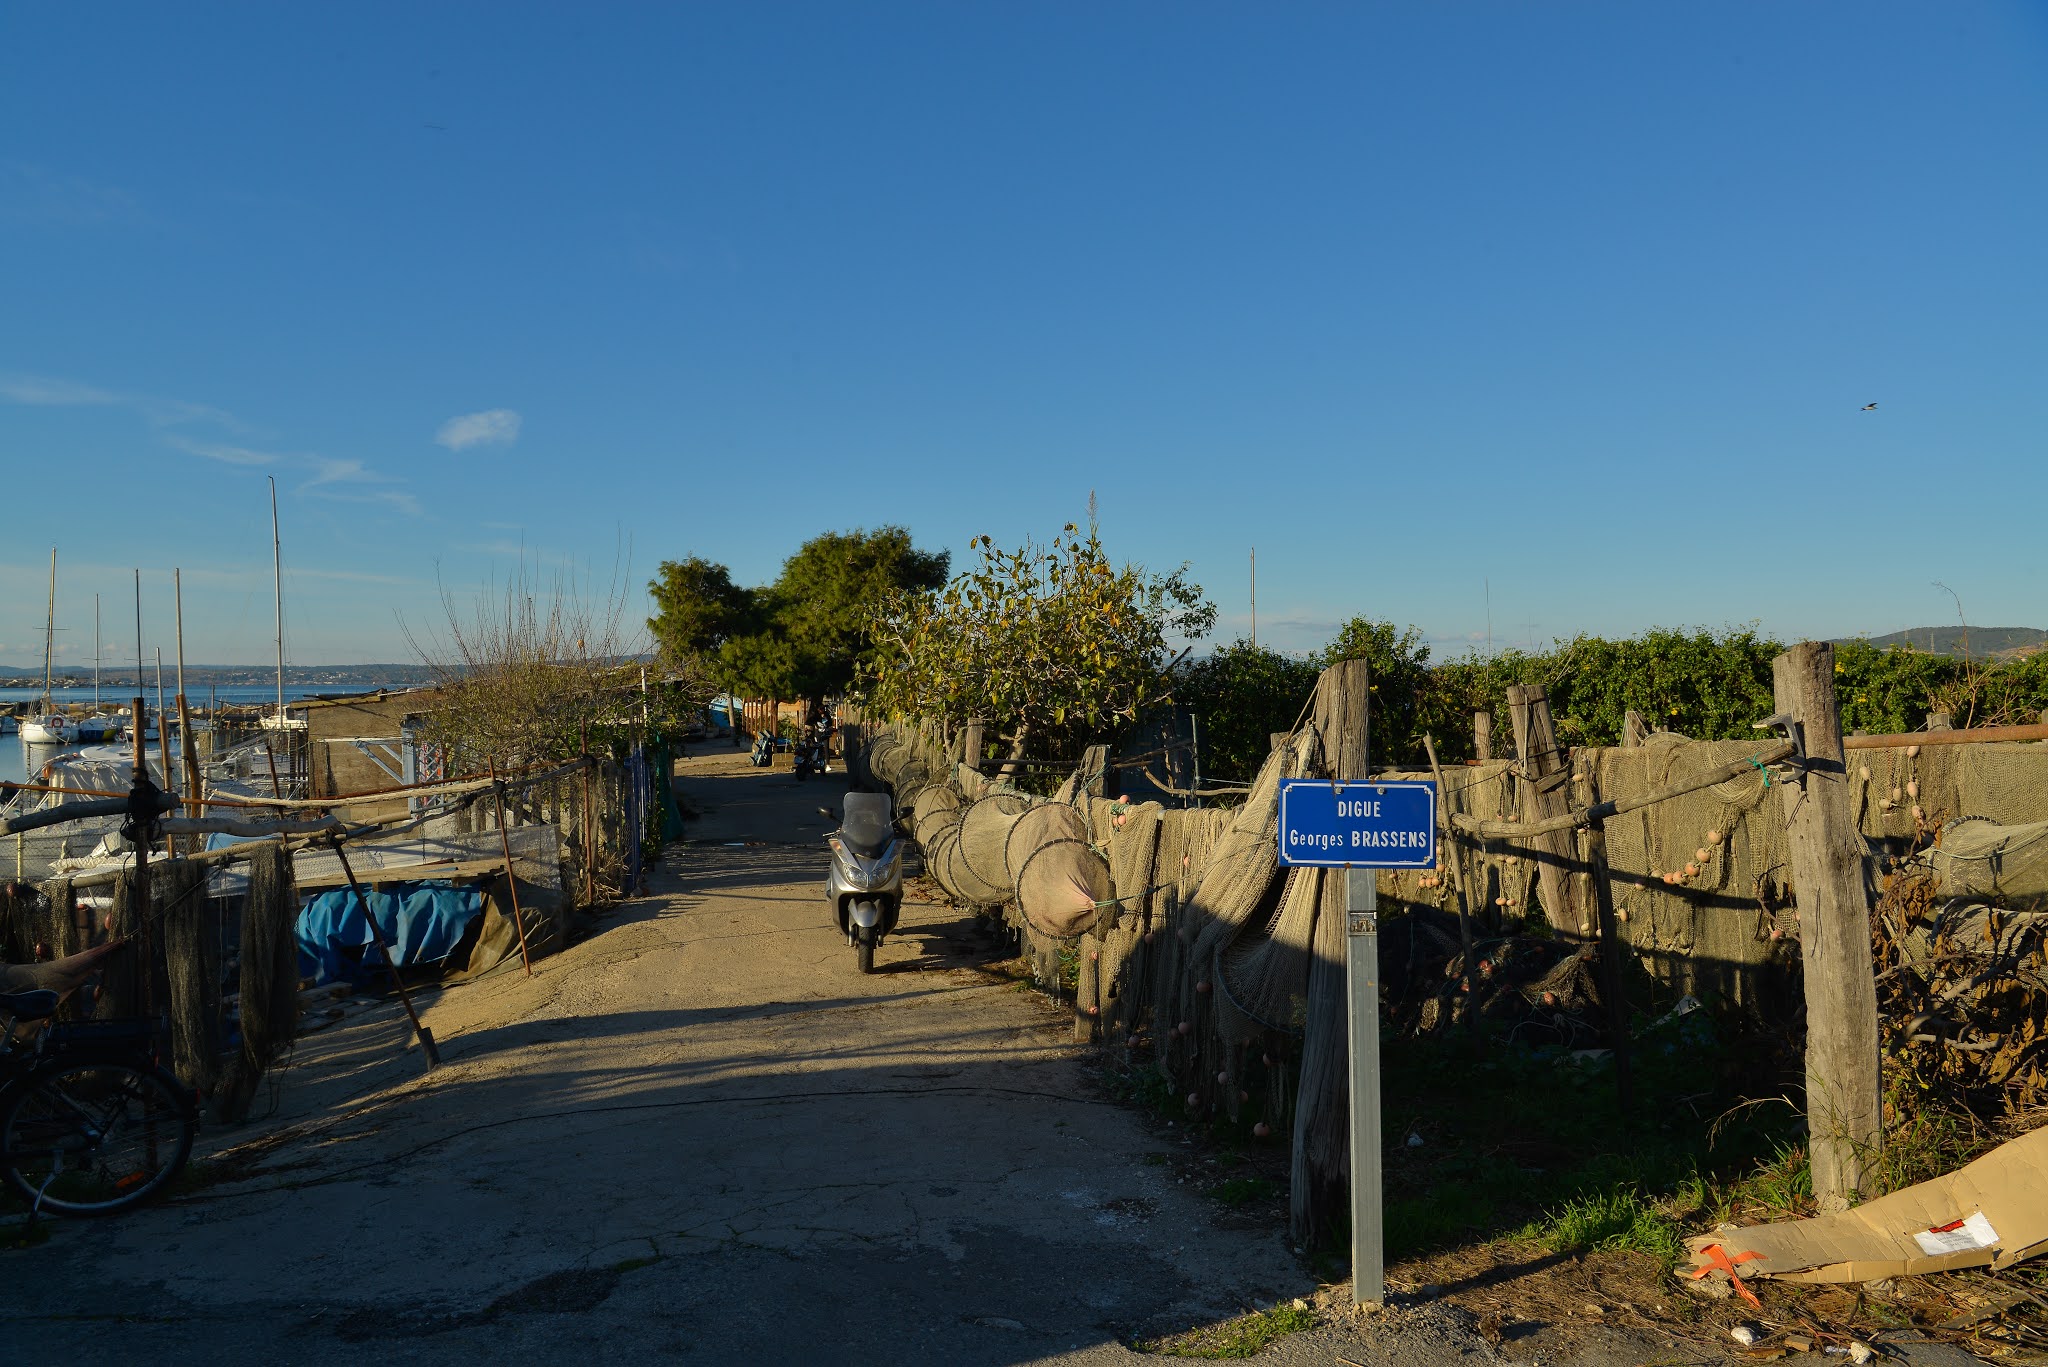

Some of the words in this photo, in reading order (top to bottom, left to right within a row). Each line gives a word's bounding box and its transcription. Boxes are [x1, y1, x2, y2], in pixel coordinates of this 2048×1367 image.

[1337, 801, 1381, 817] DIGUE
[1290, 829, 1343, 850] Georges
[1351, 830, 1427, 848] BRASSENS
